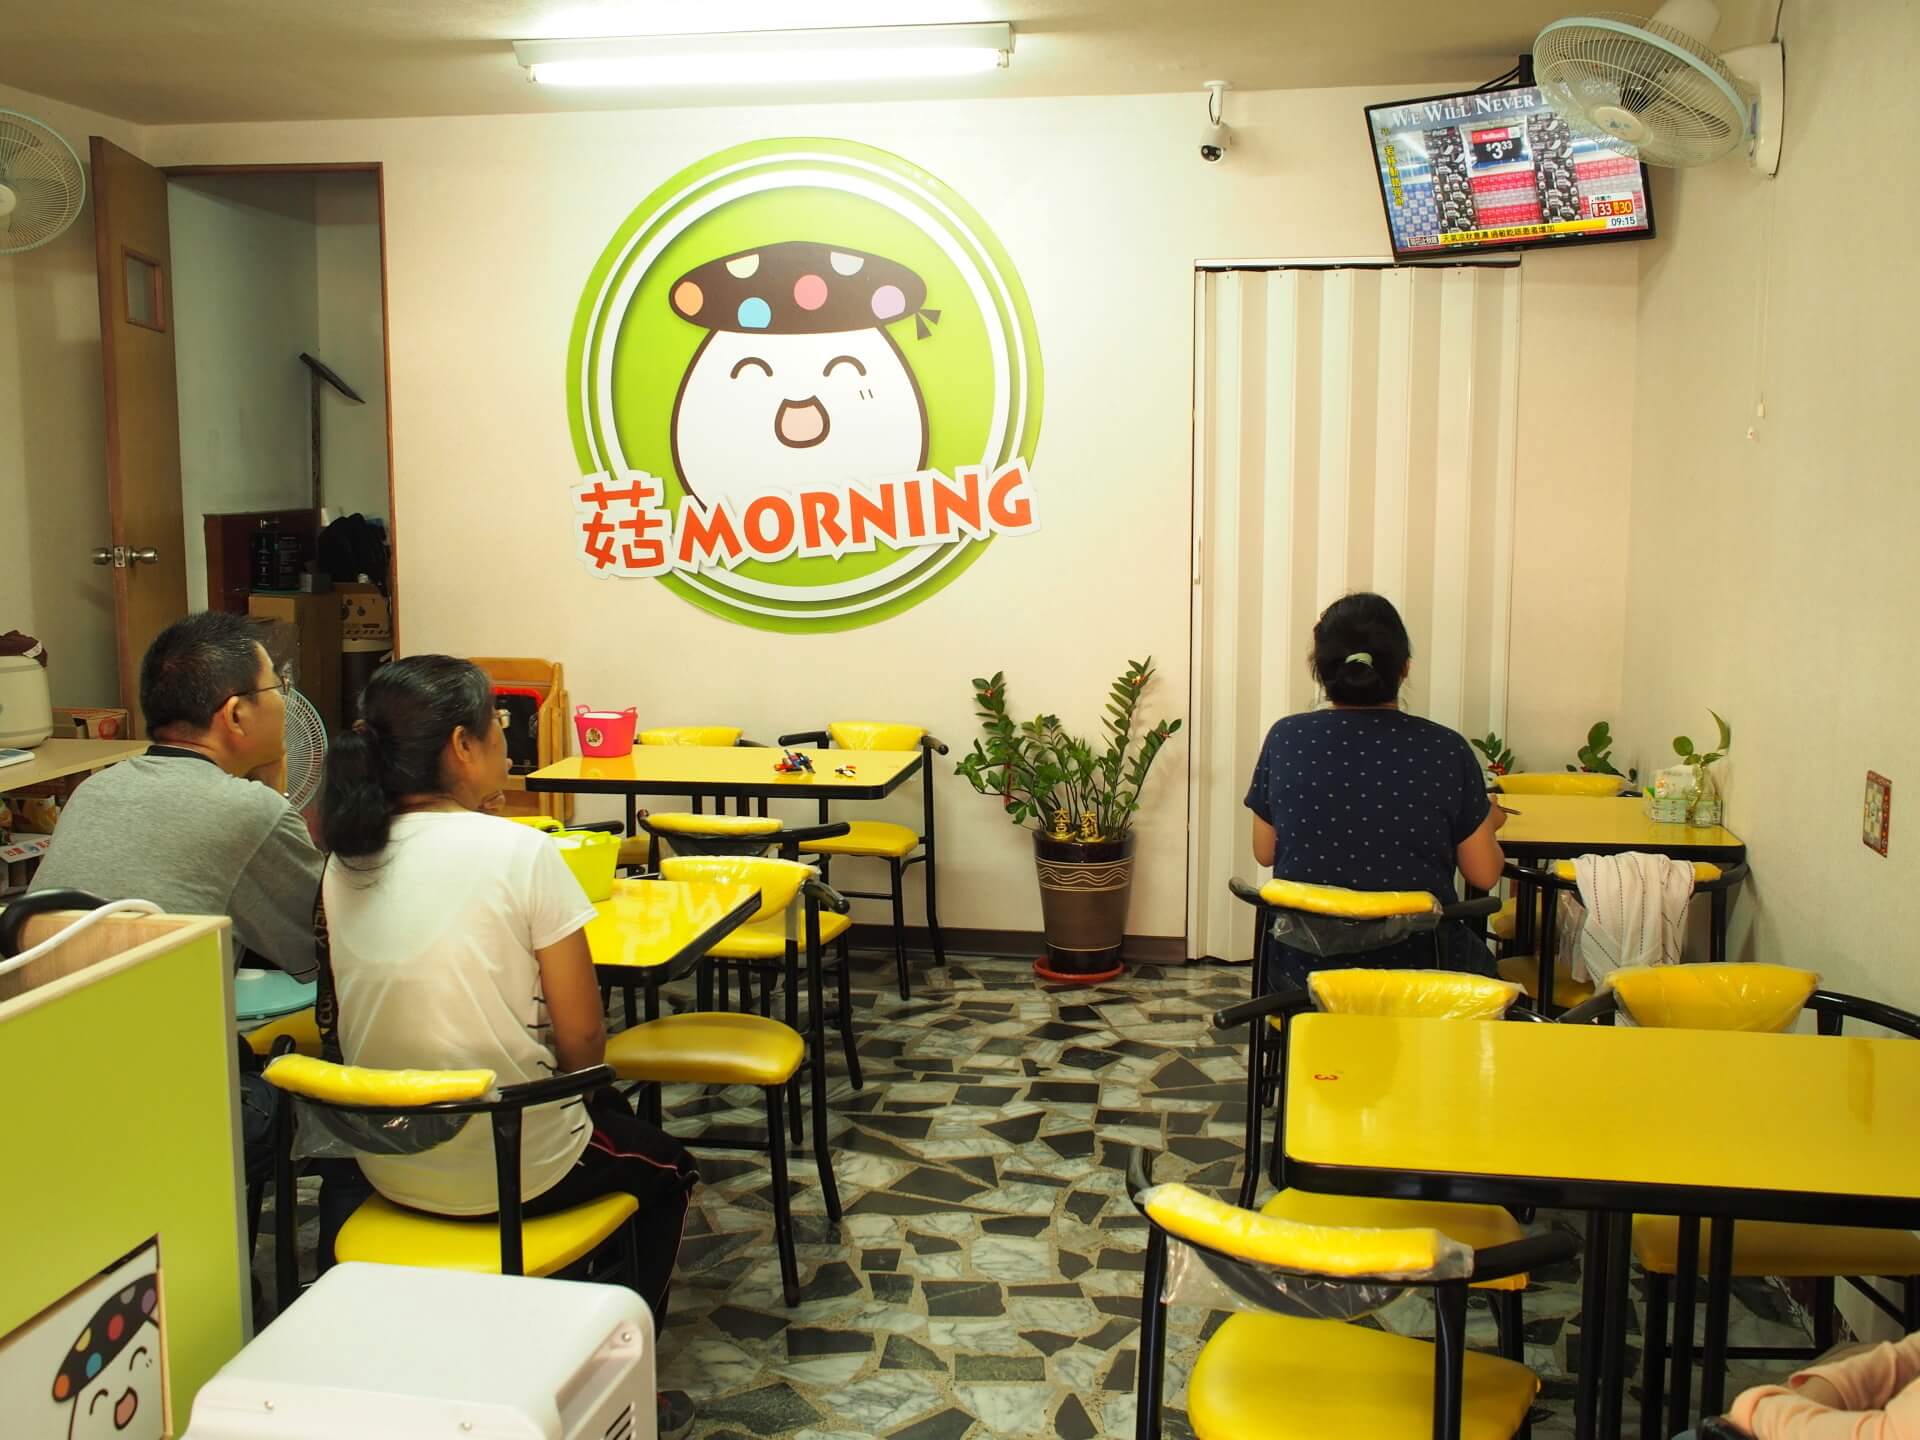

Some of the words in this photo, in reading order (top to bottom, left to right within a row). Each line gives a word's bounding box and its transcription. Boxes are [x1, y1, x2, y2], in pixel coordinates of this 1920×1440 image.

[1424, 103, 1471, 122] WILL
[1475, 94, 1534, 115] NEVER
[1598, 203, 1612, 216] 33
[1620, 201, 1632, 214] 30
[1611, 216, 1636, 226] 09:15
[581, 480, 665, 569] 菇
[679, 468, 1032, 562] MORNING
